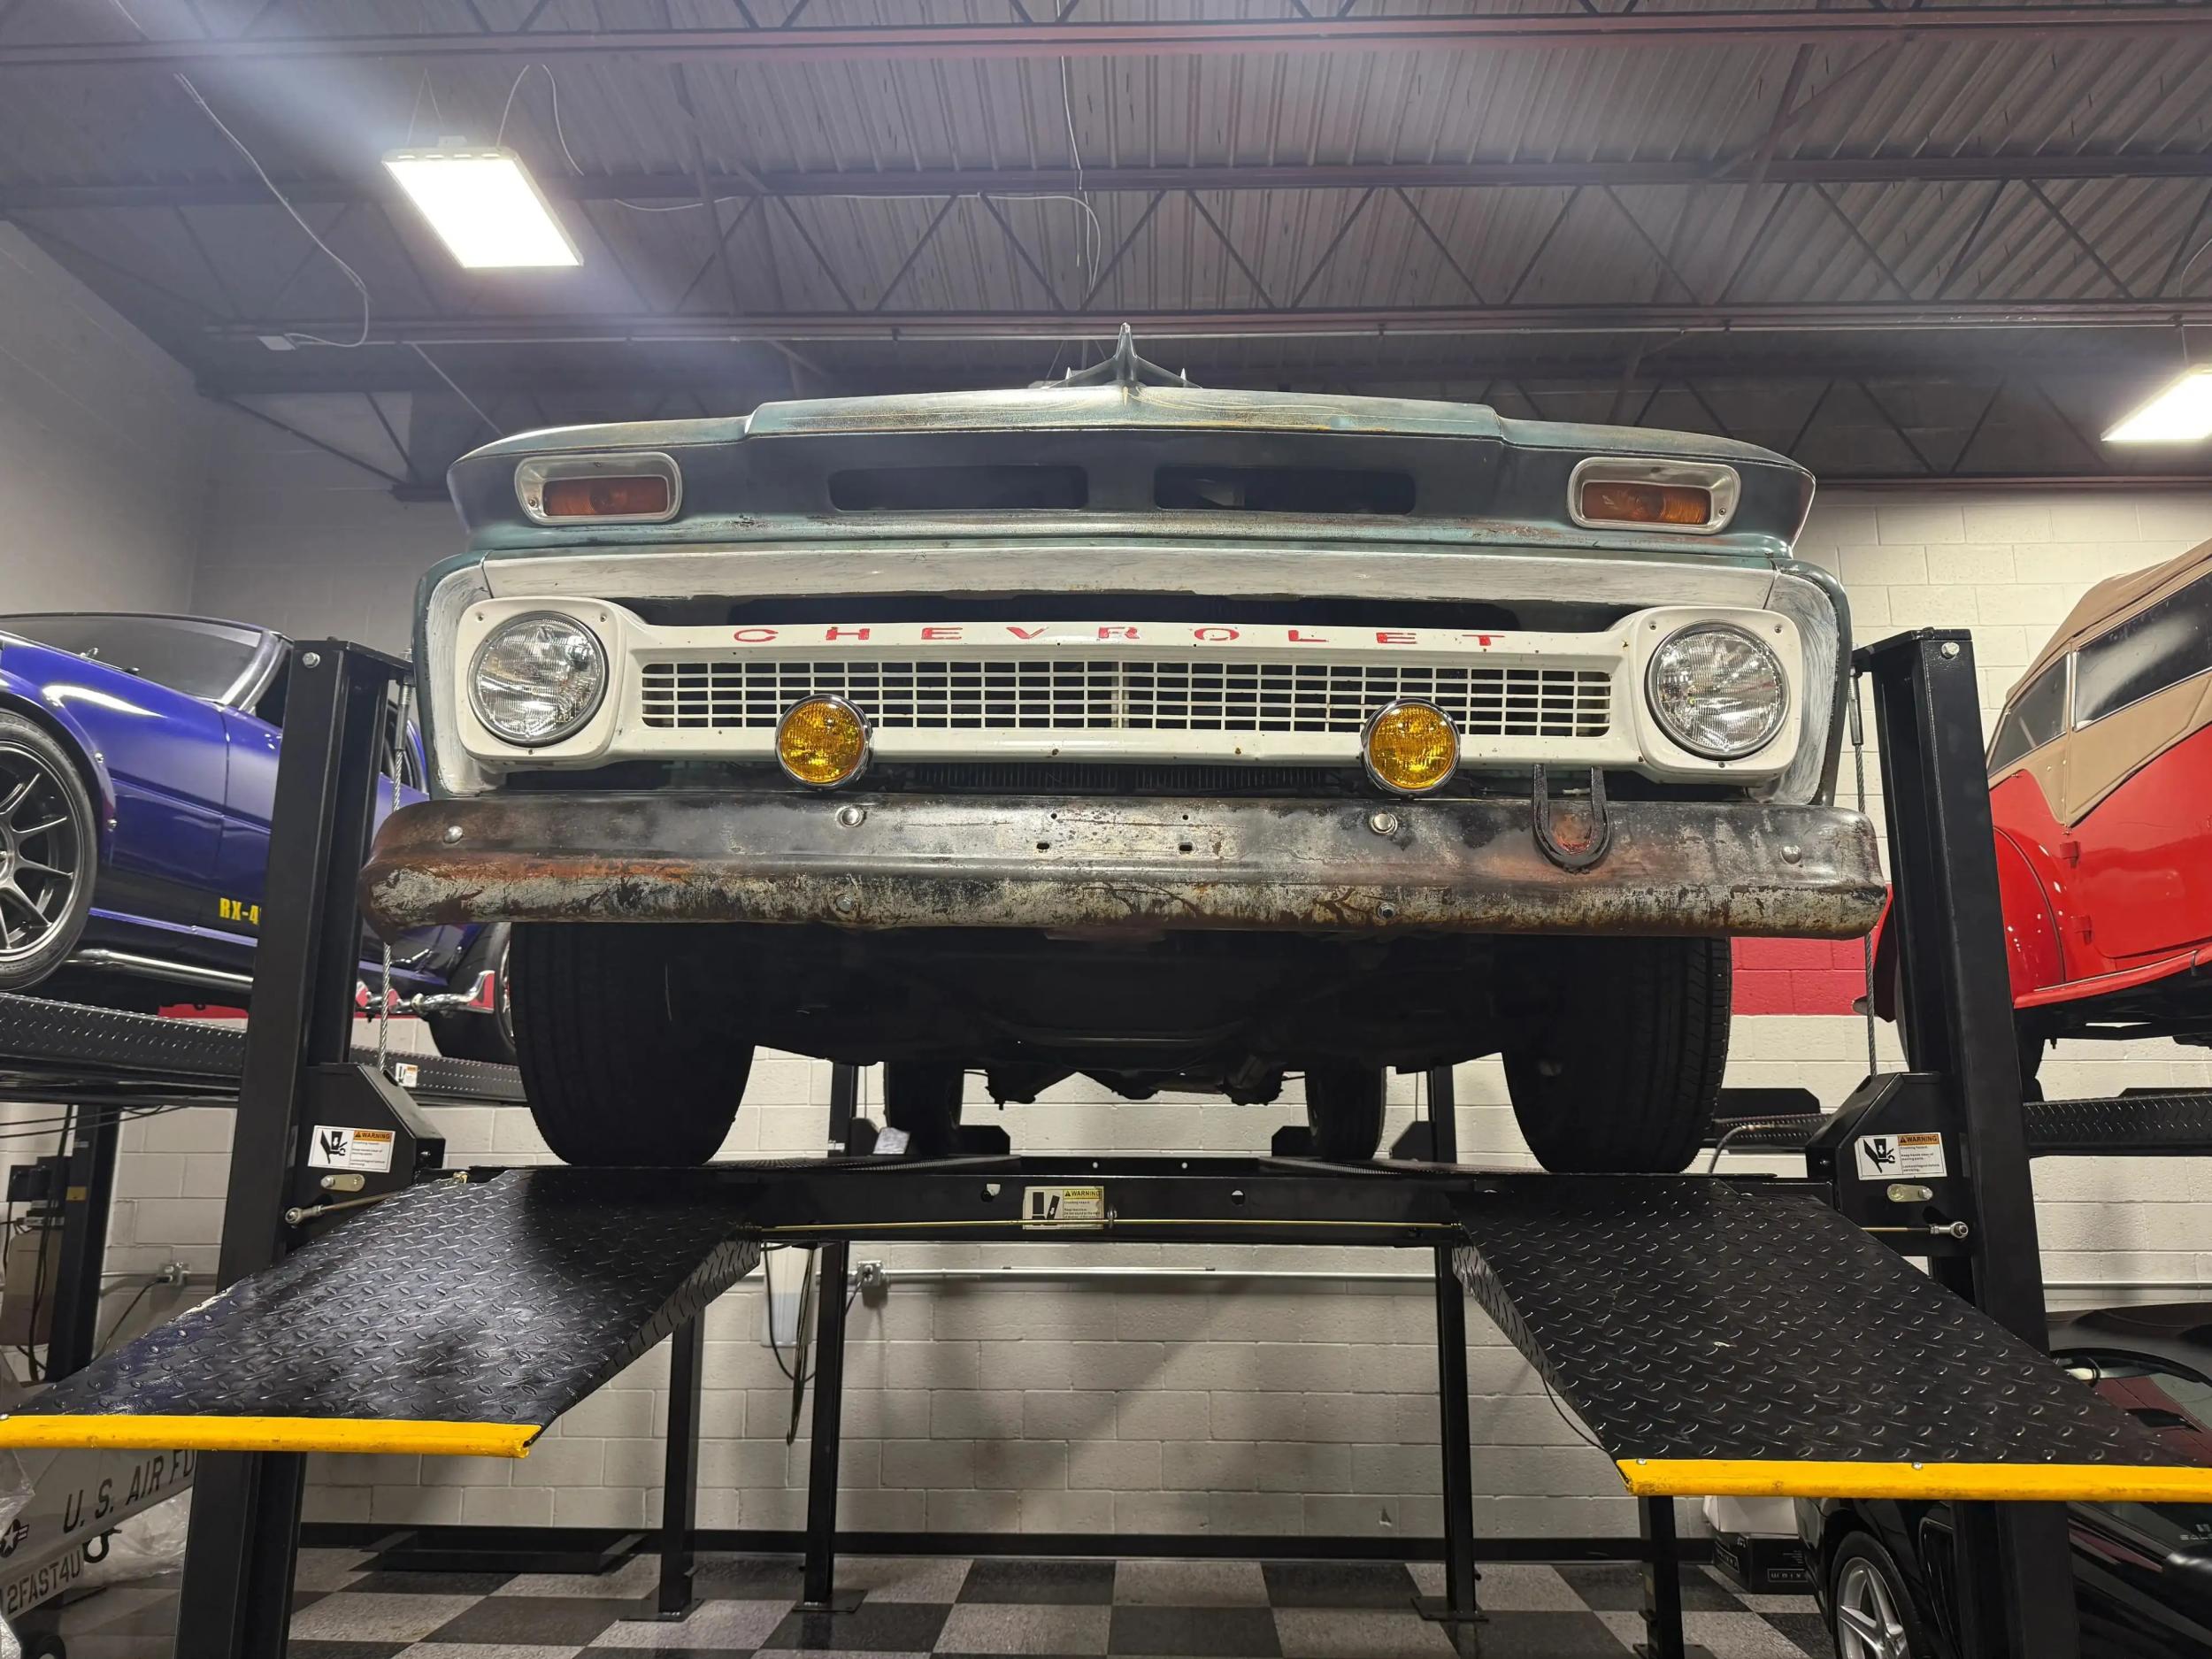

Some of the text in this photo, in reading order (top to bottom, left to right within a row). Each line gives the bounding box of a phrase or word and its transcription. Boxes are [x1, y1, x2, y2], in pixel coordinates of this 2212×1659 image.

[733, 626, 1504, 646] CHEVROLET
[219, 897, 262, 926] RX-4
[63, 1489, 84, 1533] U.
[95, 1478, 114, 1519] S.
[126, 1455, 164, 1506] AIR
[7, 1550, 81, 1615] 2FAST4U
